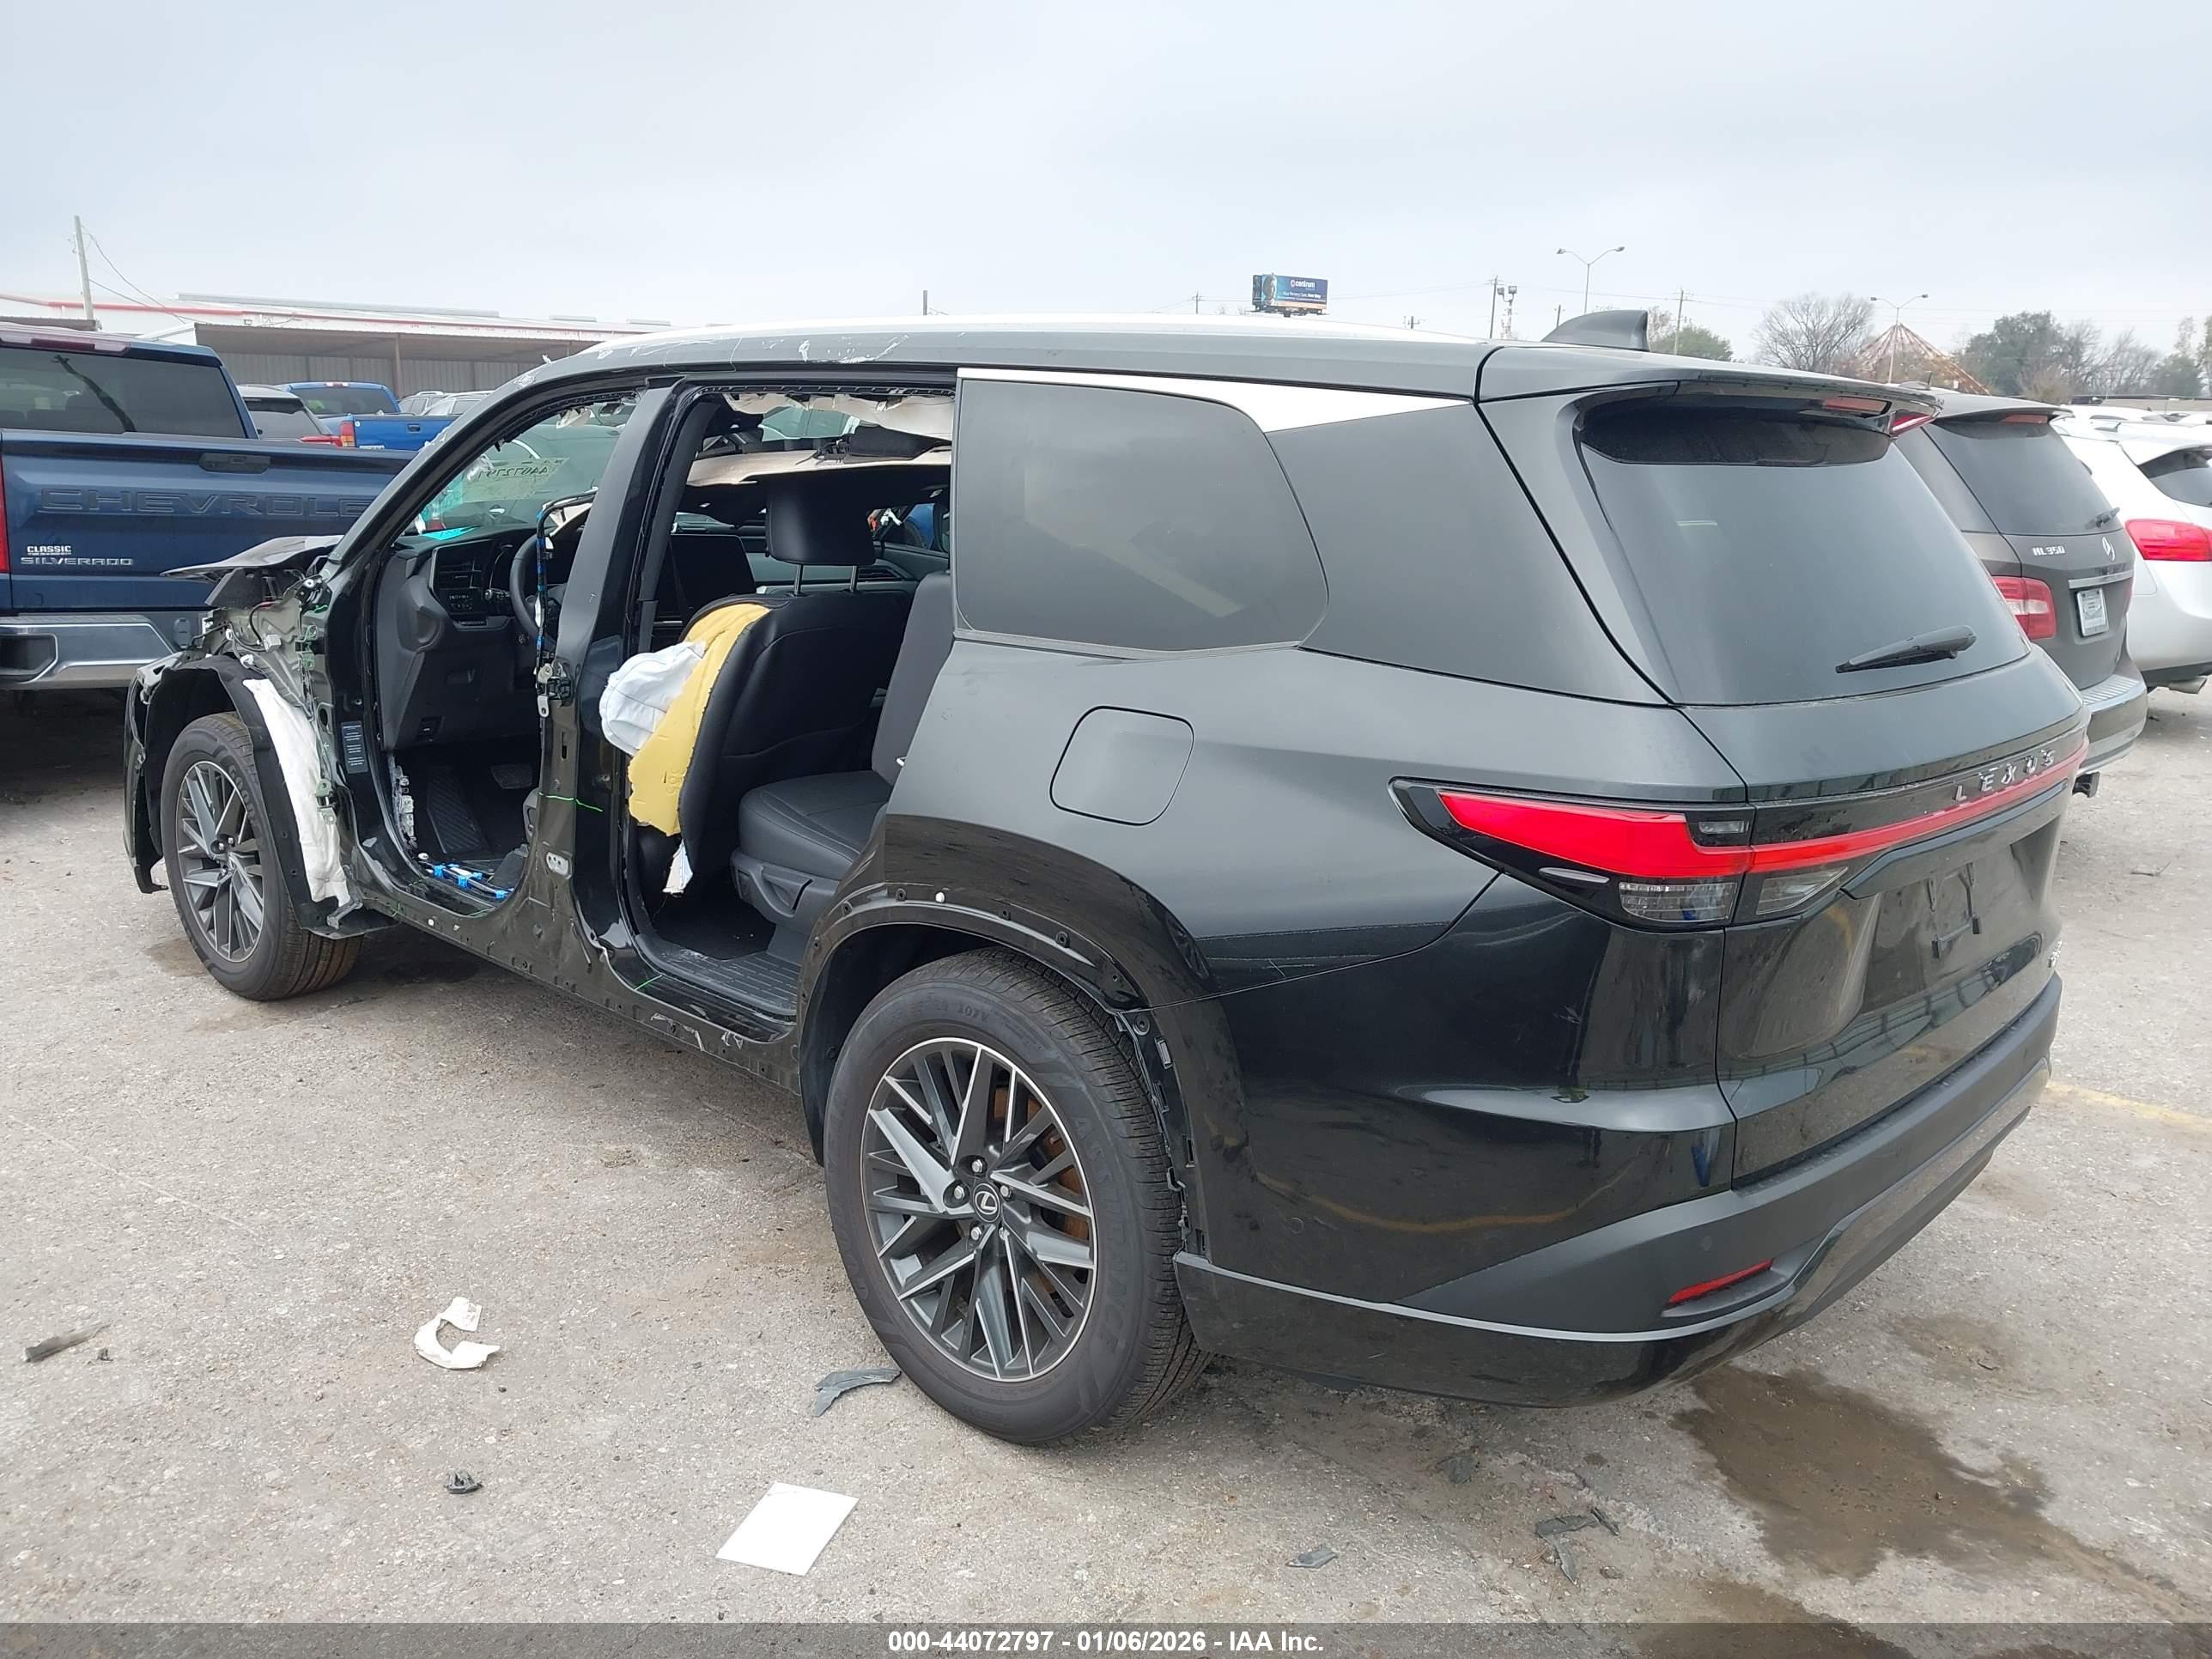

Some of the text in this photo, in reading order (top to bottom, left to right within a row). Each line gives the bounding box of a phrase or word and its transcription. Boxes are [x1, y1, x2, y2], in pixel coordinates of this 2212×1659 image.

[38, 488, 374, 517] CHEVROLE
[27, 545, 72, 554] CLASSIC
[20, 556, 134, 566] SILVERADO
[1952, 748, 2057, 802] LEXUS
